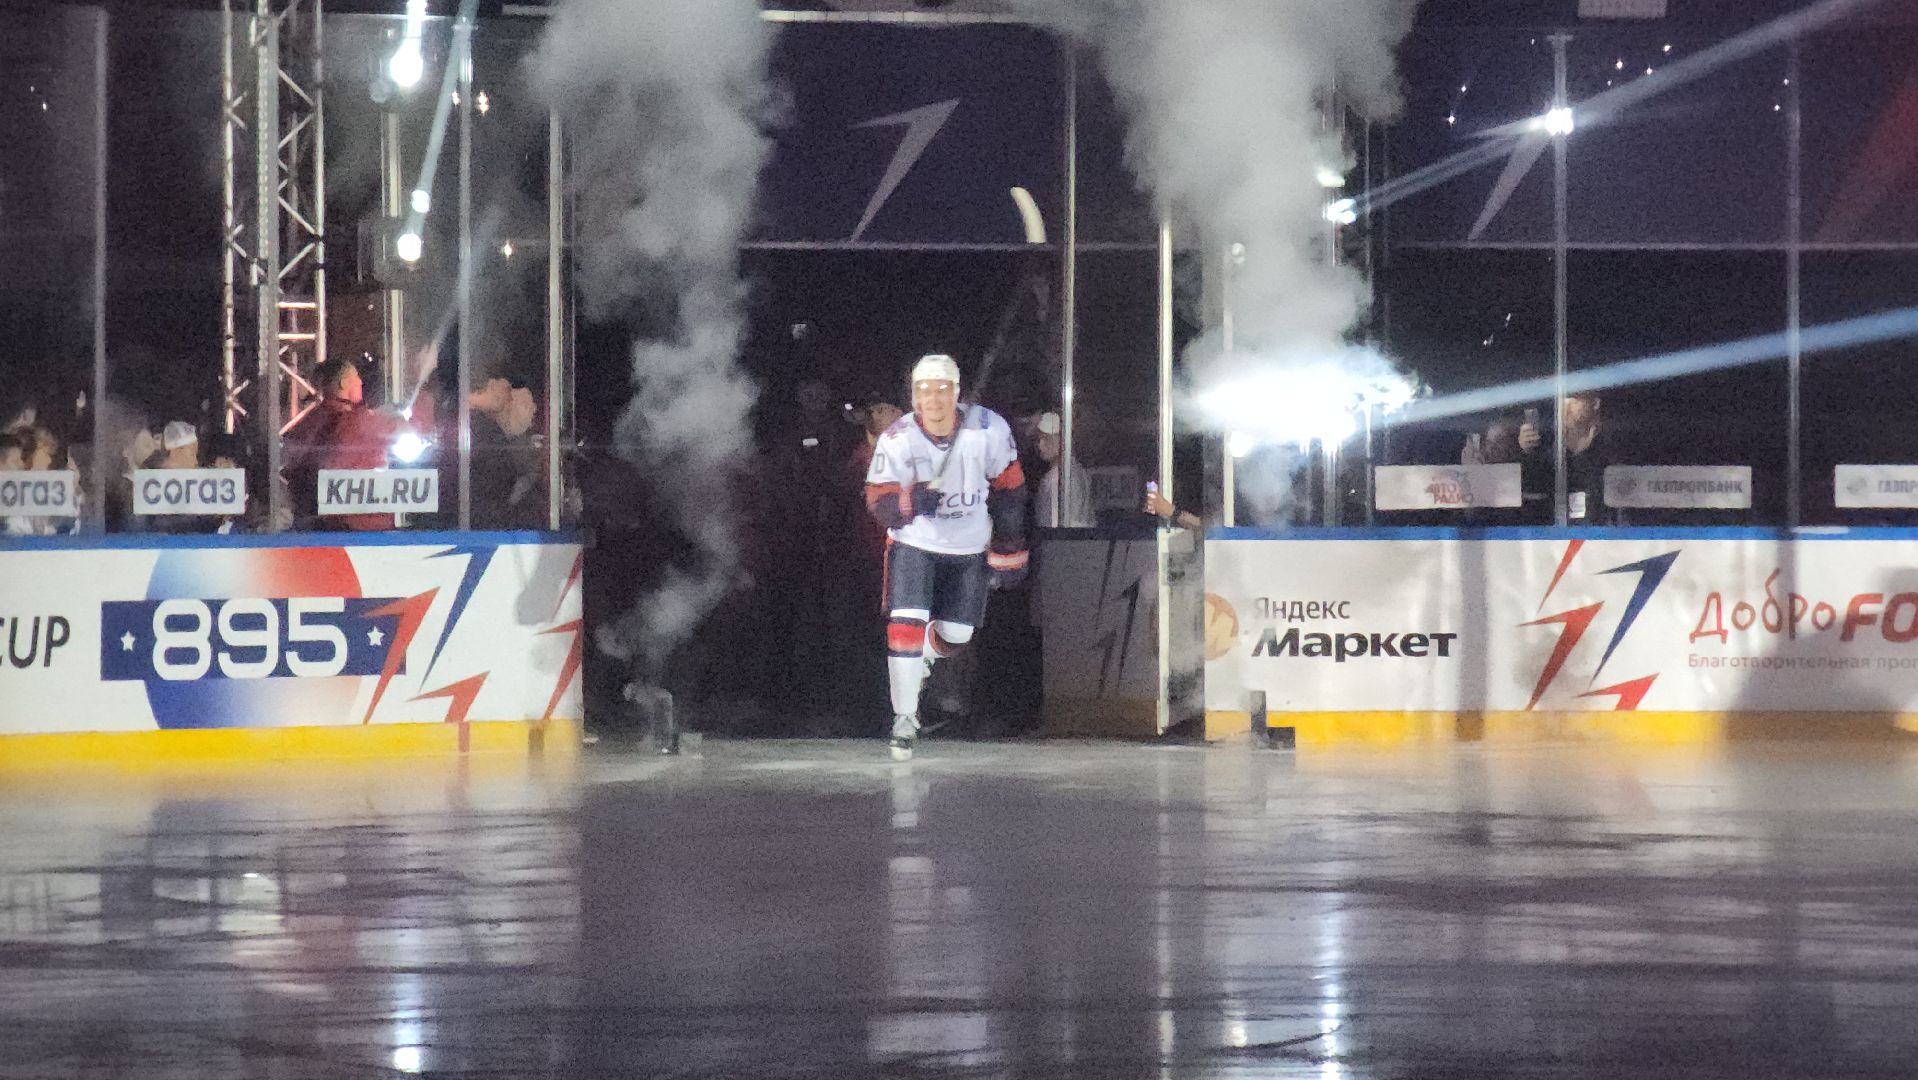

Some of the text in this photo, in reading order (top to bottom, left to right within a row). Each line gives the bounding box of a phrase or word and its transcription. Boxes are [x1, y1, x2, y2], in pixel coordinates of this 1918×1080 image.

[326, 477, 431, 504] KHL.RU
[1647, 480, 1743, 494] ГАЗПРОМБАНК
[1253, 597, 1351, 622] Яндекс
[0, 615, 70, 669] UP
[153, 597, 348, 681] 895
[1252, 627, 1457, 662] Маркет
[1688, 653, 1870, 671] Благотворительная
